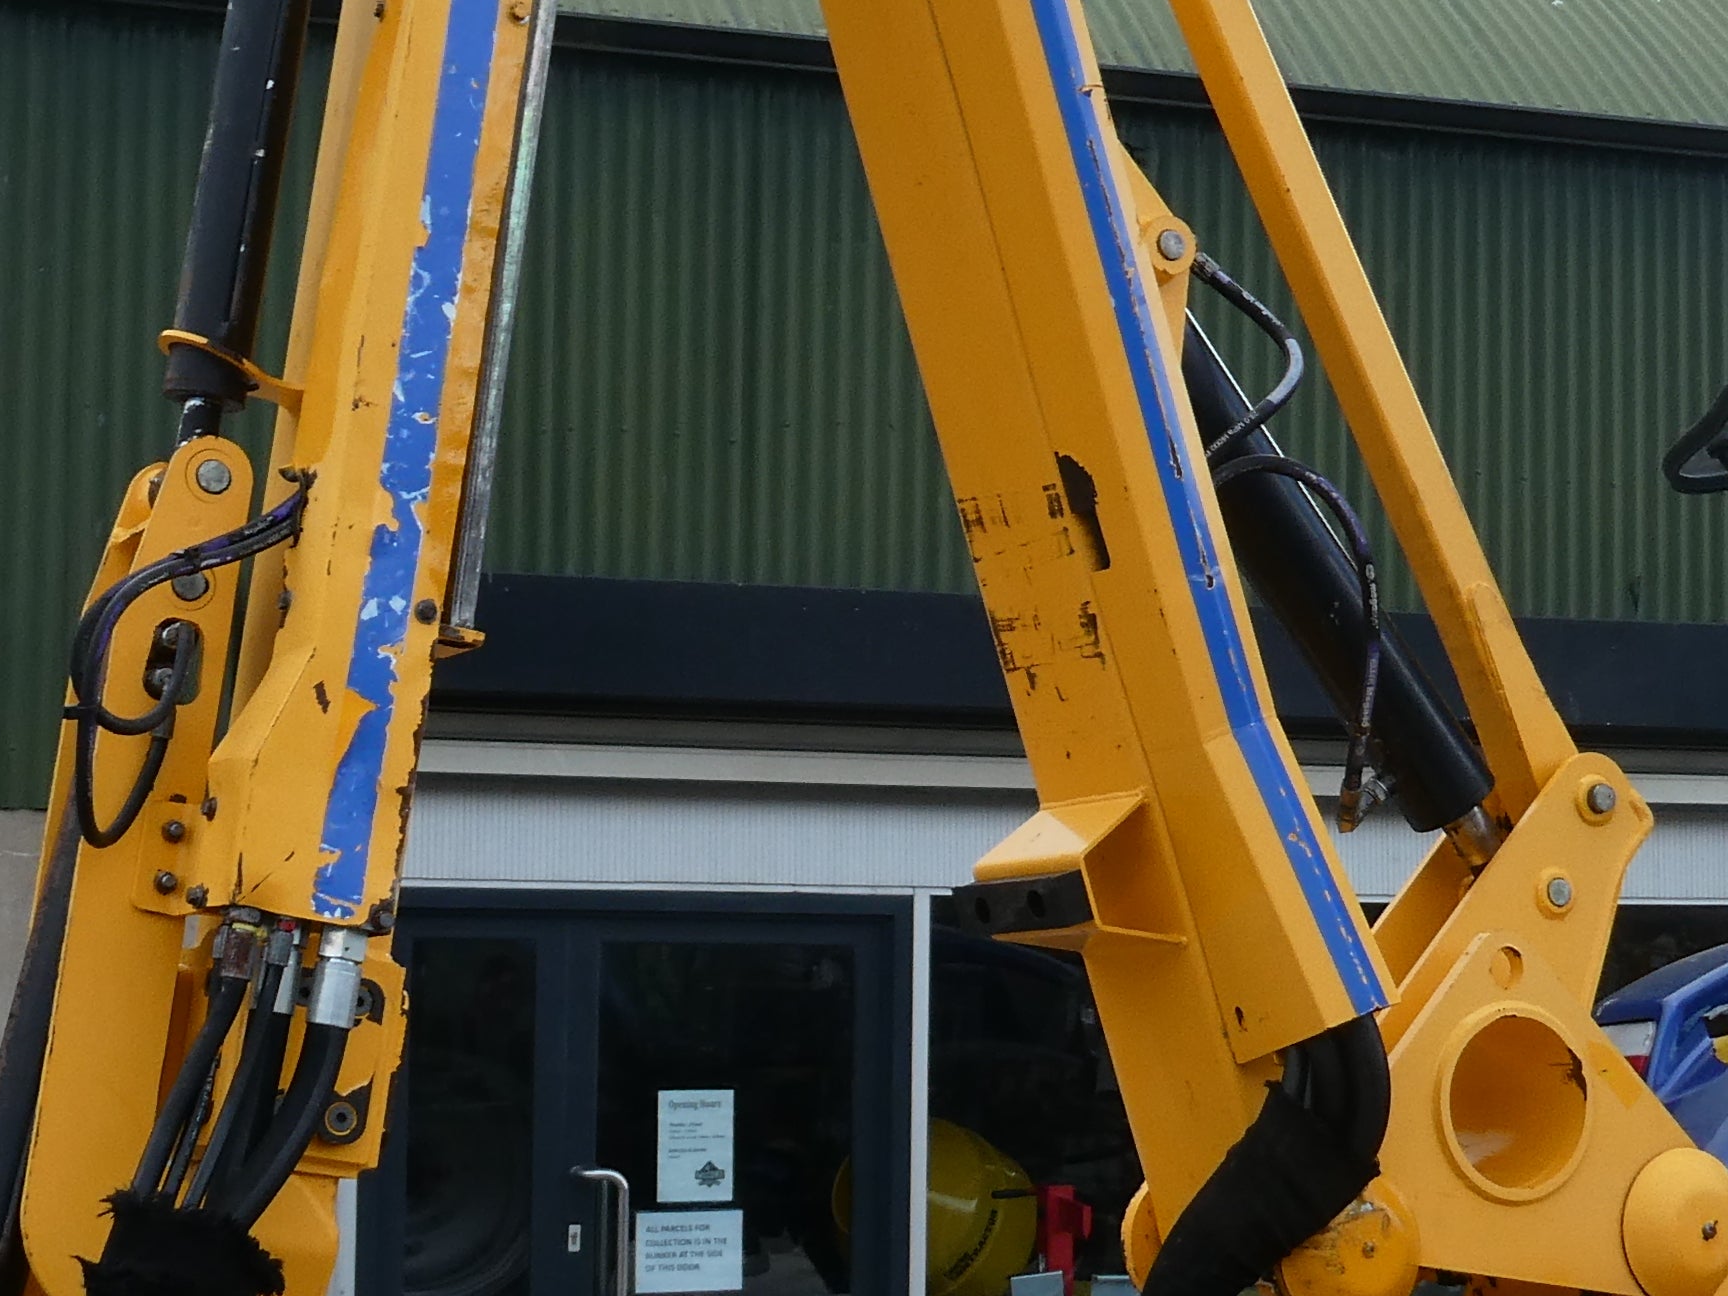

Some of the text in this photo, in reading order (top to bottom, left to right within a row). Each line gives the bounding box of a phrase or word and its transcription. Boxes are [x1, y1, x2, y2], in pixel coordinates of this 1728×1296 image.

[645, 1225, 660, 1233] ALL
[695, 1223, 710, 1232] FOR
[714, 1236, 728, 1245] THE
[679, 1250, 688, 1259] AT
[690, 1250, 705, 1258] THE
